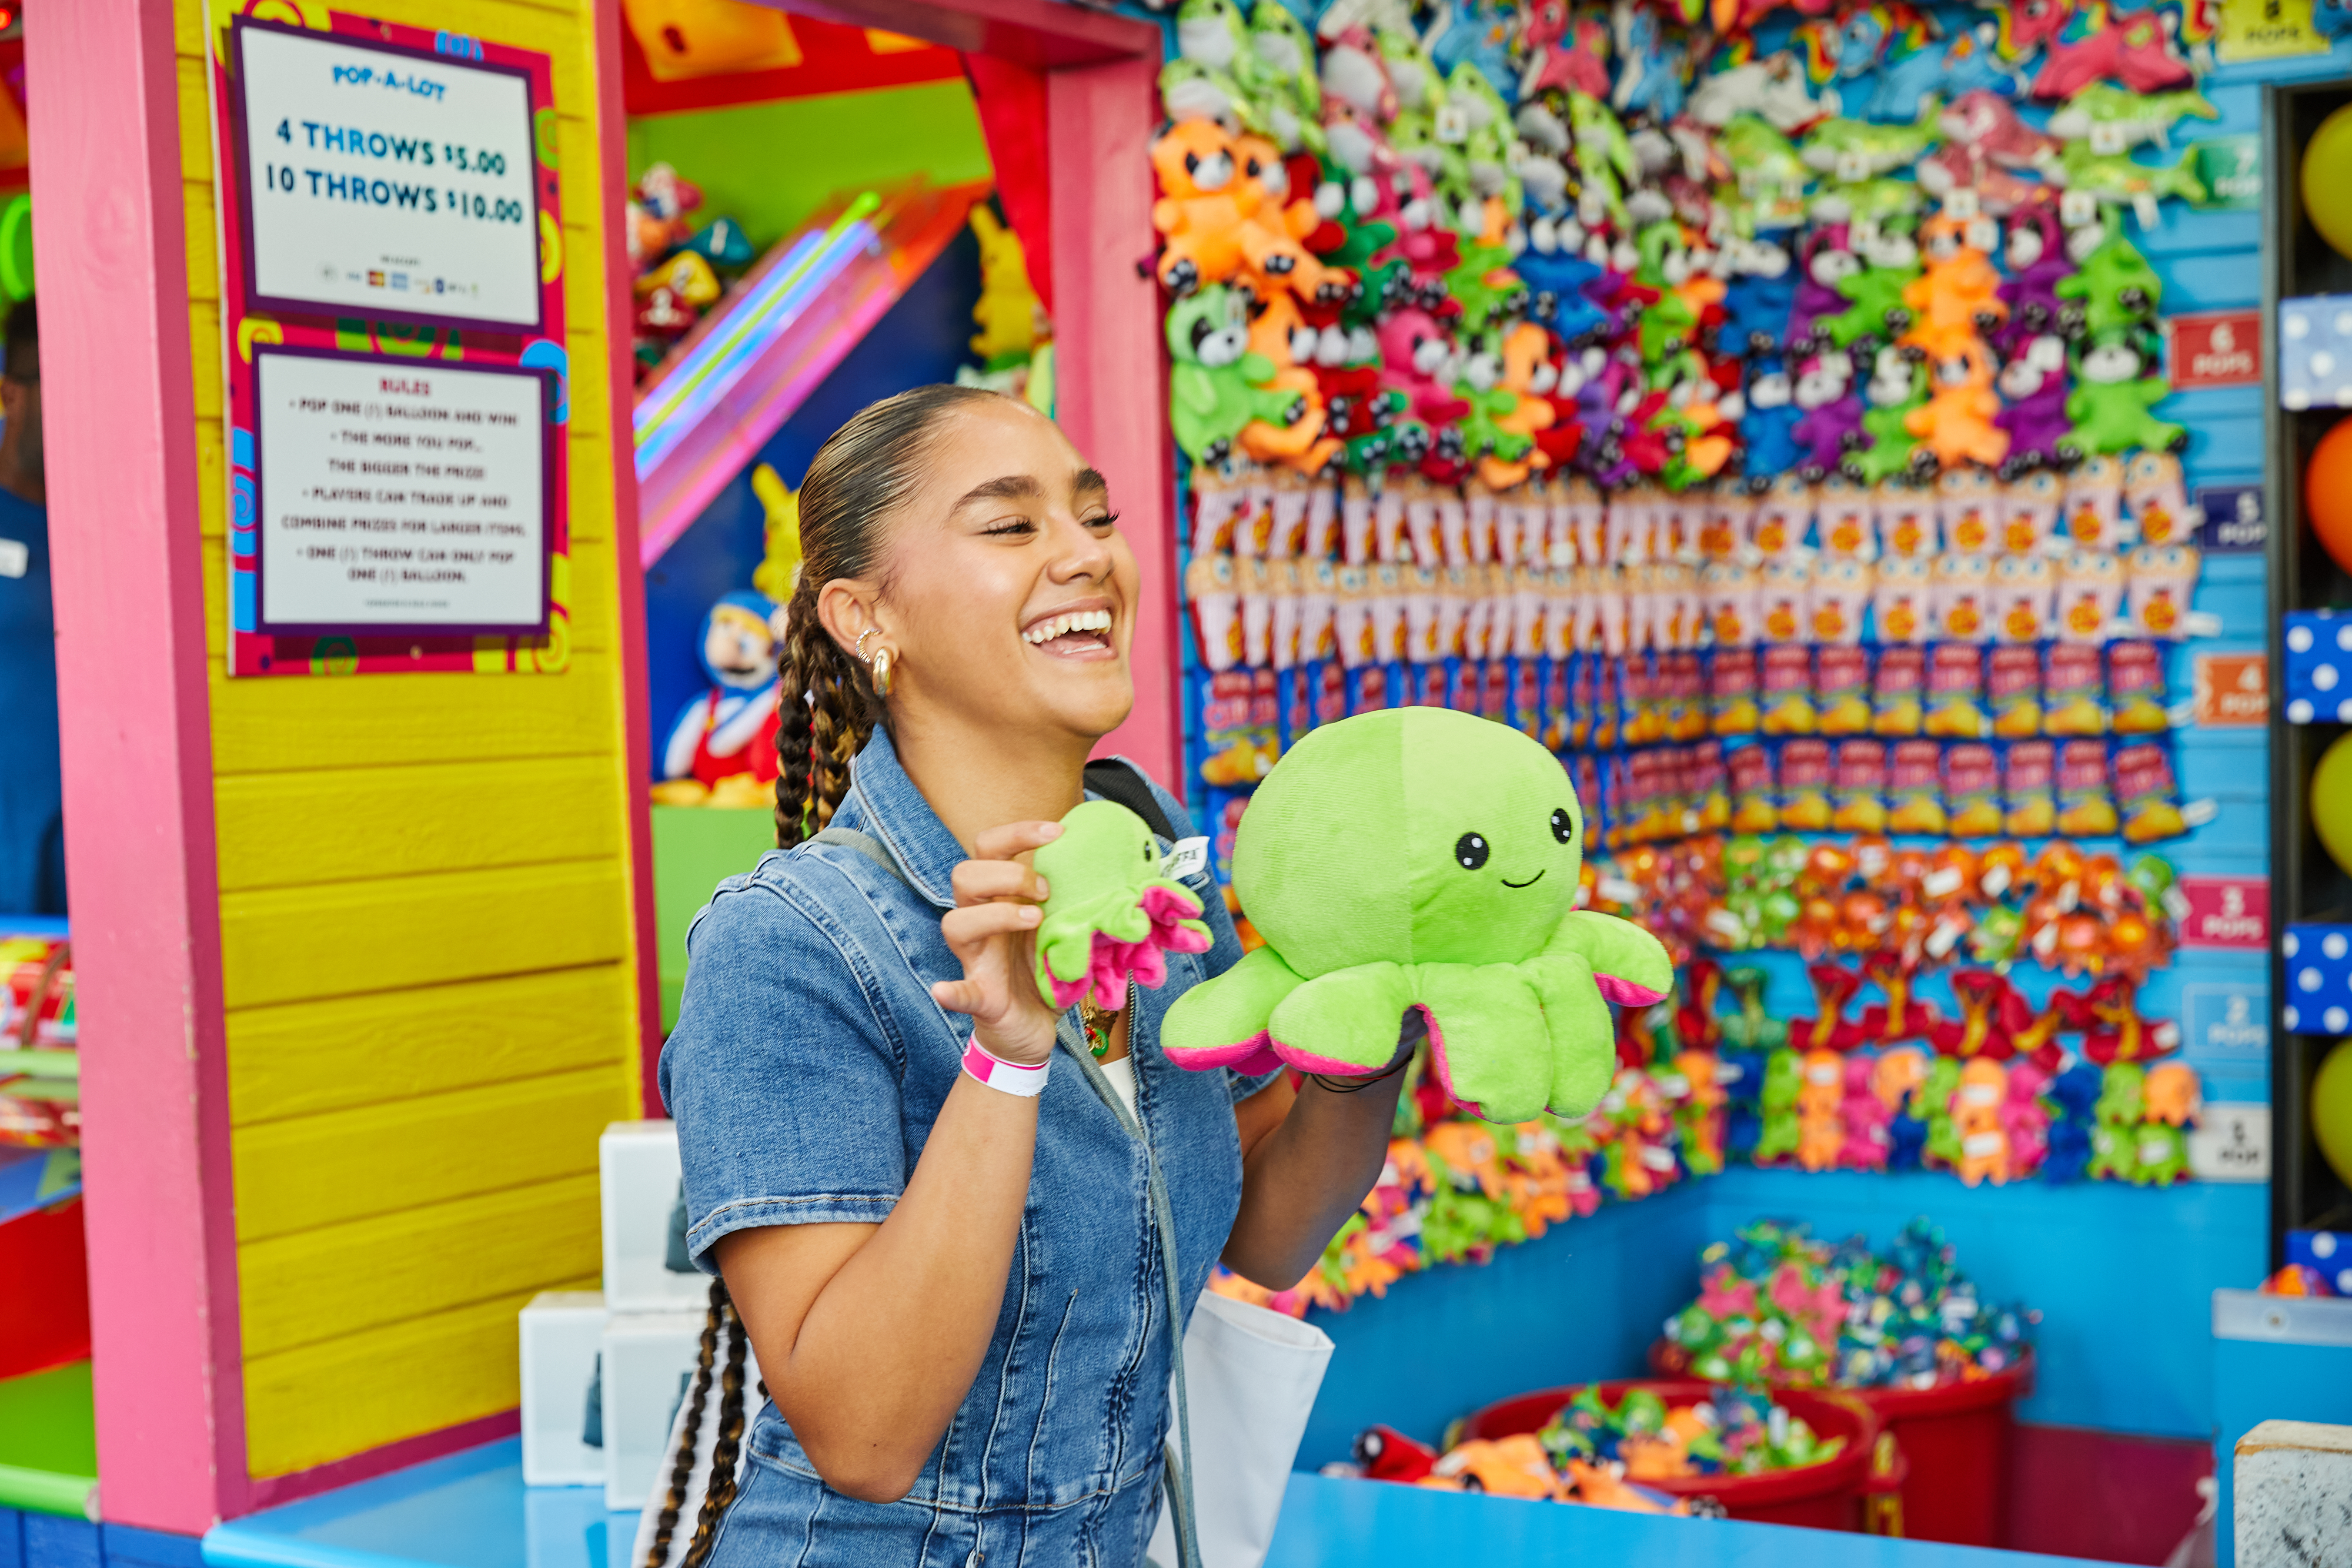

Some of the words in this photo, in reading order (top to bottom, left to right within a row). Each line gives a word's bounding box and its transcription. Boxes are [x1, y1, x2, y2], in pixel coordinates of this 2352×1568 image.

[276, 119, 292, 144] 4
[301, 121, 435, 166] THROWS
[445, 142, 506, 176] $5.00
[268, 163, 295, 192] 10
[305, 169, 436, 212] THROWS
[447, 189, 523, 223] $10.00
[2210, 322, 2235, 353] 6
[2193, 350, 2254, 376] POPS
[380, 377, 431, 396] RULES
[385, 404, 451, 422] BALLOON
[2236, 492, 2259, 523] 5
[2237, 663, 2264, 691] 4
[2221, 885, 2246, 917] 3
[2202, 915, 2264, 940] POPS
[2226, 995, 2250, 1026] 2
